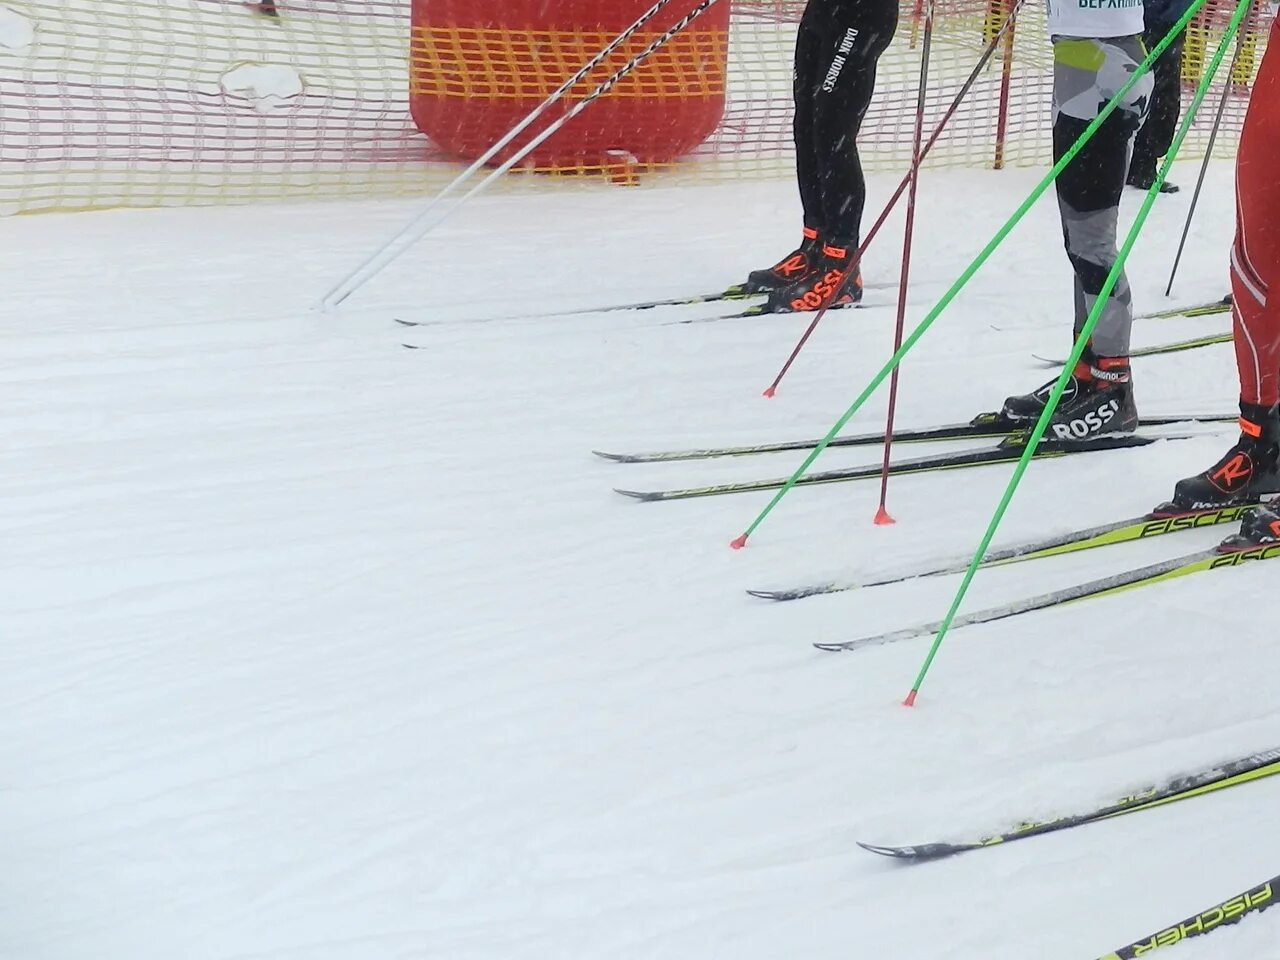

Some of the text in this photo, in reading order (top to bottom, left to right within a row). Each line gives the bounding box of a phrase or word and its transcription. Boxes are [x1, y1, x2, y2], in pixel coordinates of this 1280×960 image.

[822, 27, 859, 93] DARK HORSES
[1052, 399, 1120, 440] ROSSI
[1132, 883, 1274, 957] FISCHER
